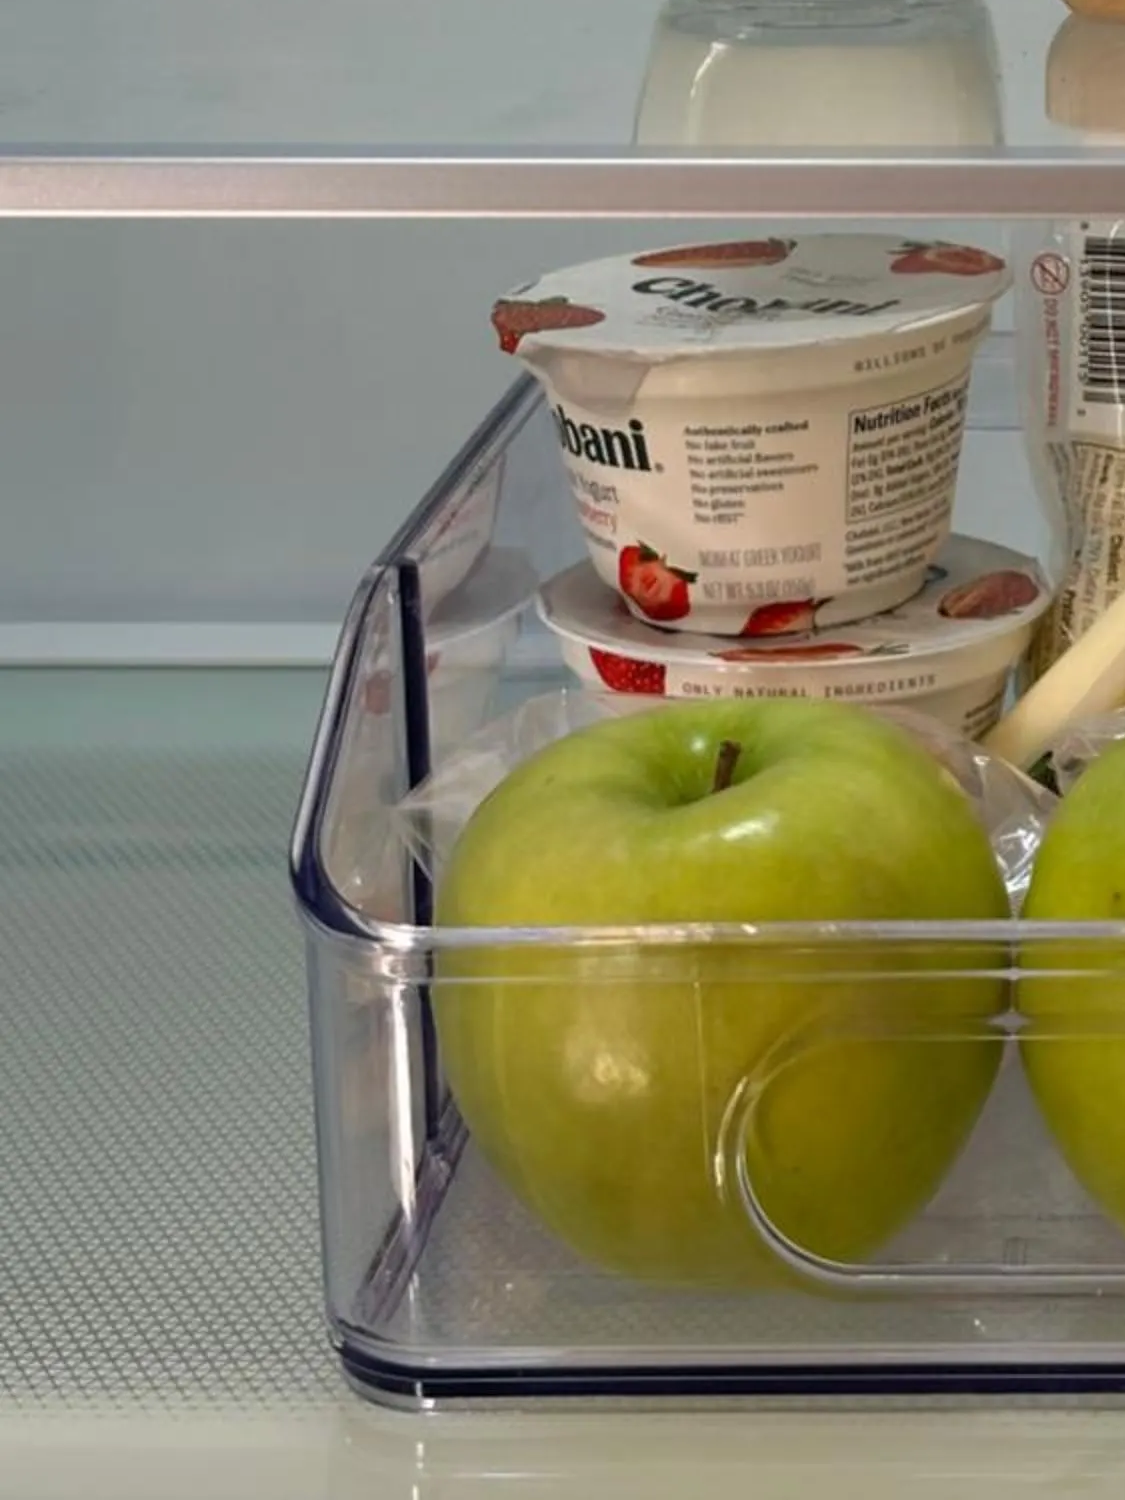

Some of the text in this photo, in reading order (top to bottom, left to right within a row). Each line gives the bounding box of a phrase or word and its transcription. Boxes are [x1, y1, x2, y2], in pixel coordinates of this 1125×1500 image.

[853, 403, 922, 434] Nutrition
[681, 673, 937, 698] ONLY NATURAL INGREDIENTS
